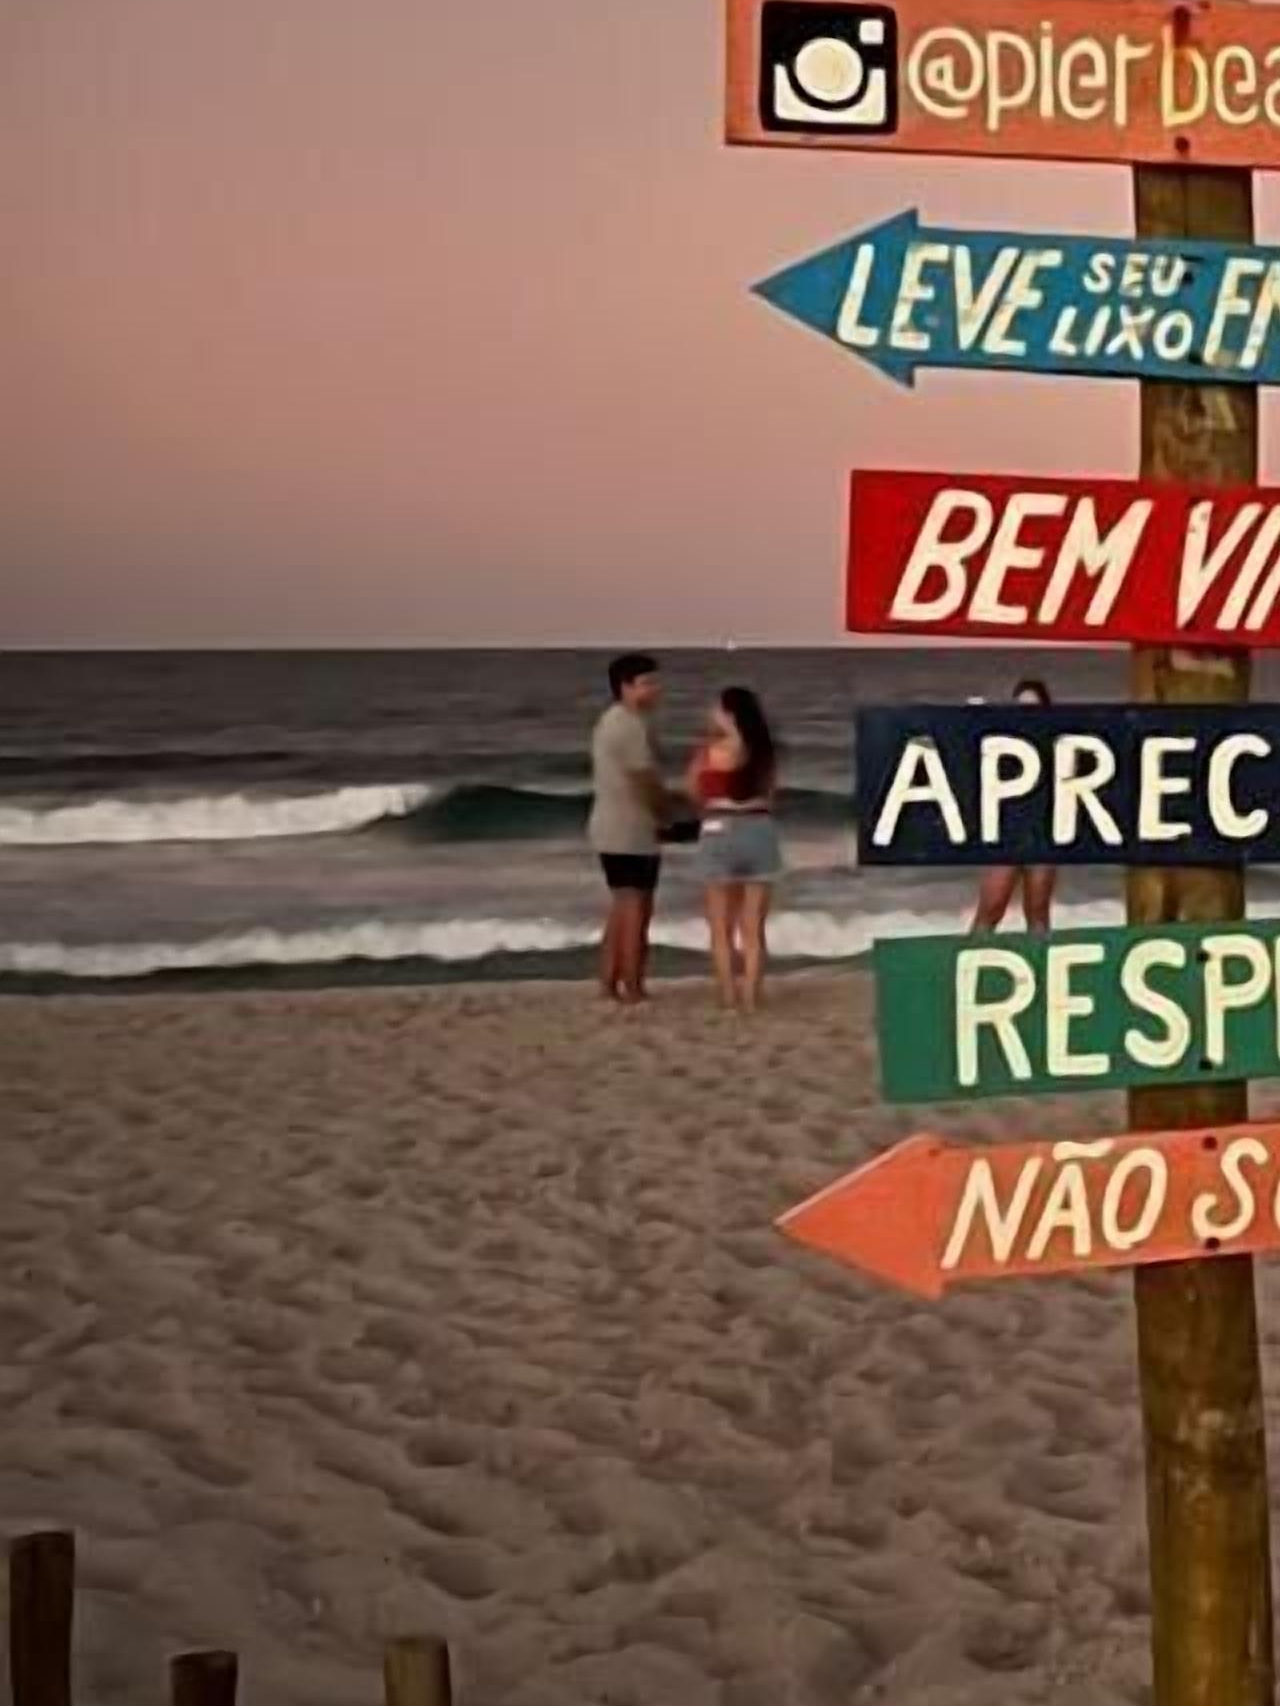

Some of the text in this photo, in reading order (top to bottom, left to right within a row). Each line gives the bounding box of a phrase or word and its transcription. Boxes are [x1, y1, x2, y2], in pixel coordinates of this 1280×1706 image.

[836, 241, 1063, 355] LEVE
[1082, 253, 1184, 296] SEU
[1048, 305, 1194, 359] LIXO
[890, 490, 1154, 626] BEM
[940, 1139, 1168, 1269] NÃO
